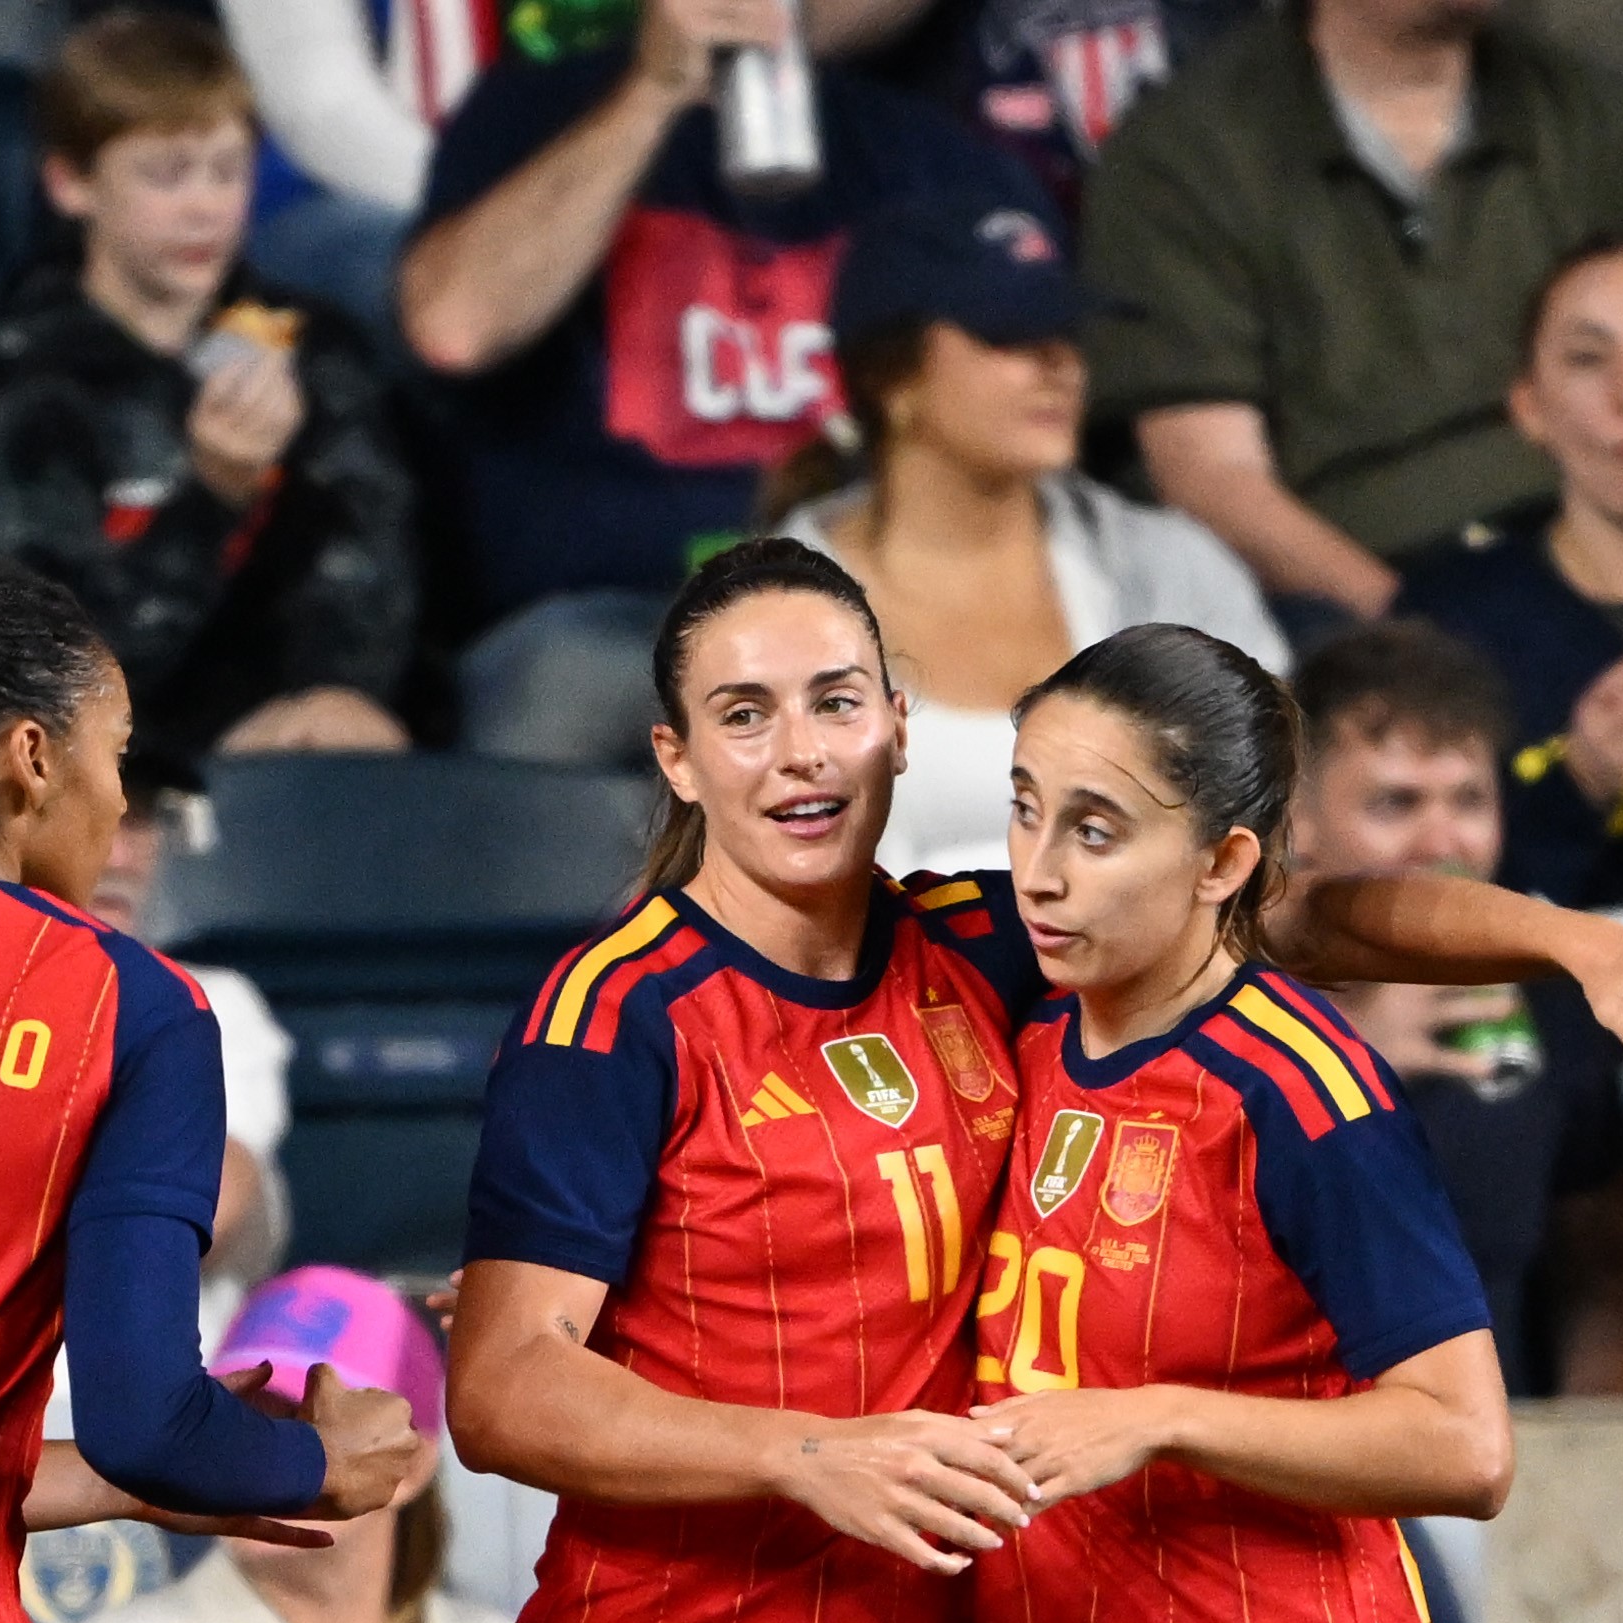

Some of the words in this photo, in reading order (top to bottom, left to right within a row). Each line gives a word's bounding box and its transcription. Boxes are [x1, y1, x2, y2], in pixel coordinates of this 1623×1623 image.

[866, 1088, 901, 1103] FIFA
[876, 1144, 963, 1302] 11
[977, 1230, 1086, 1394] 20
